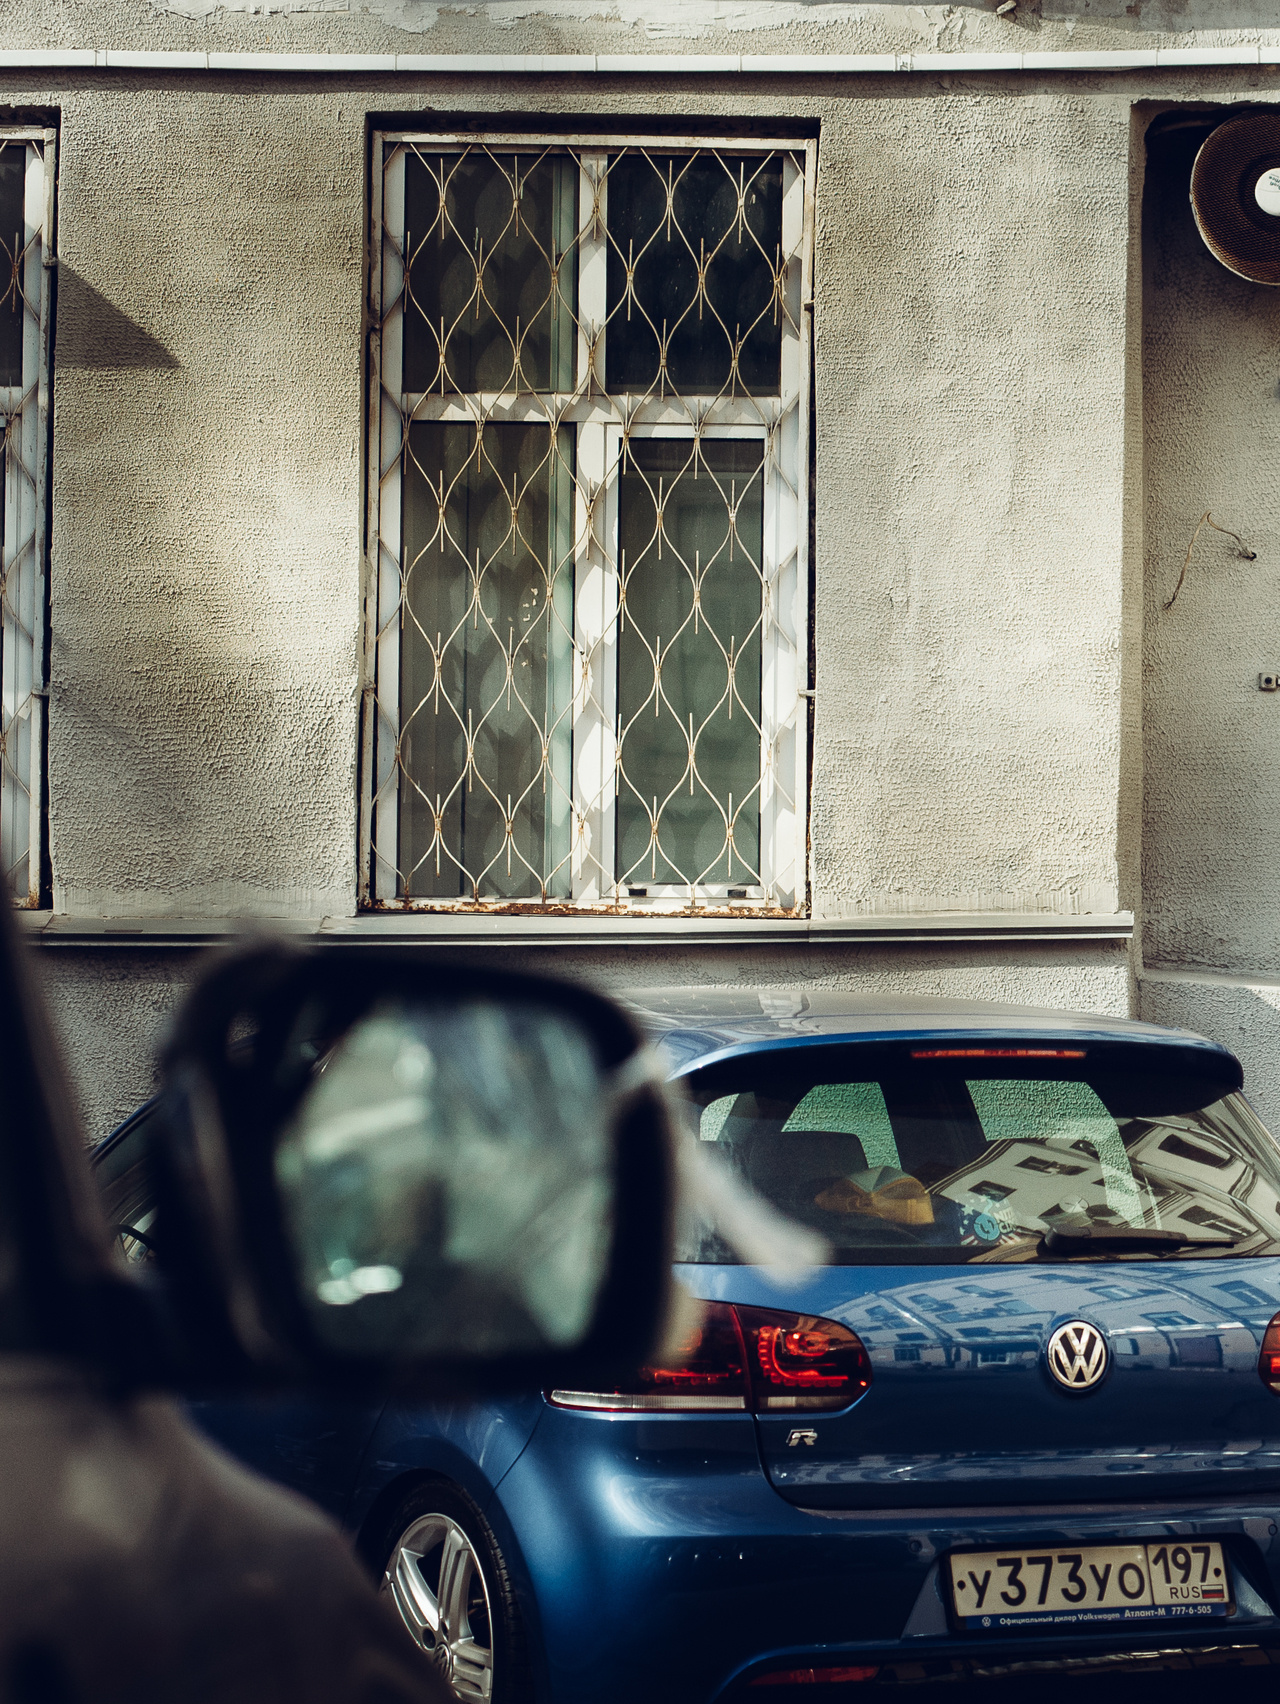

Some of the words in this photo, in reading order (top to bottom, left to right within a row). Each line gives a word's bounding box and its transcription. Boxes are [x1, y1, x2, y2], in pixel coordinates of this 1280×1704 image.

[785, 1428, 818, 1447] R
[1152, 1546, 1210, 1584] 197
[1169, 1585, 1201, 1600] RUS
[999, 1615, 1054, 1626] Официальный
[1054, 1614, 1077, 1623] дилер
[1078, 1612, 1121, 1621] Volkswagen
[1124, 1608, 1166, 1618] Атлант-М
